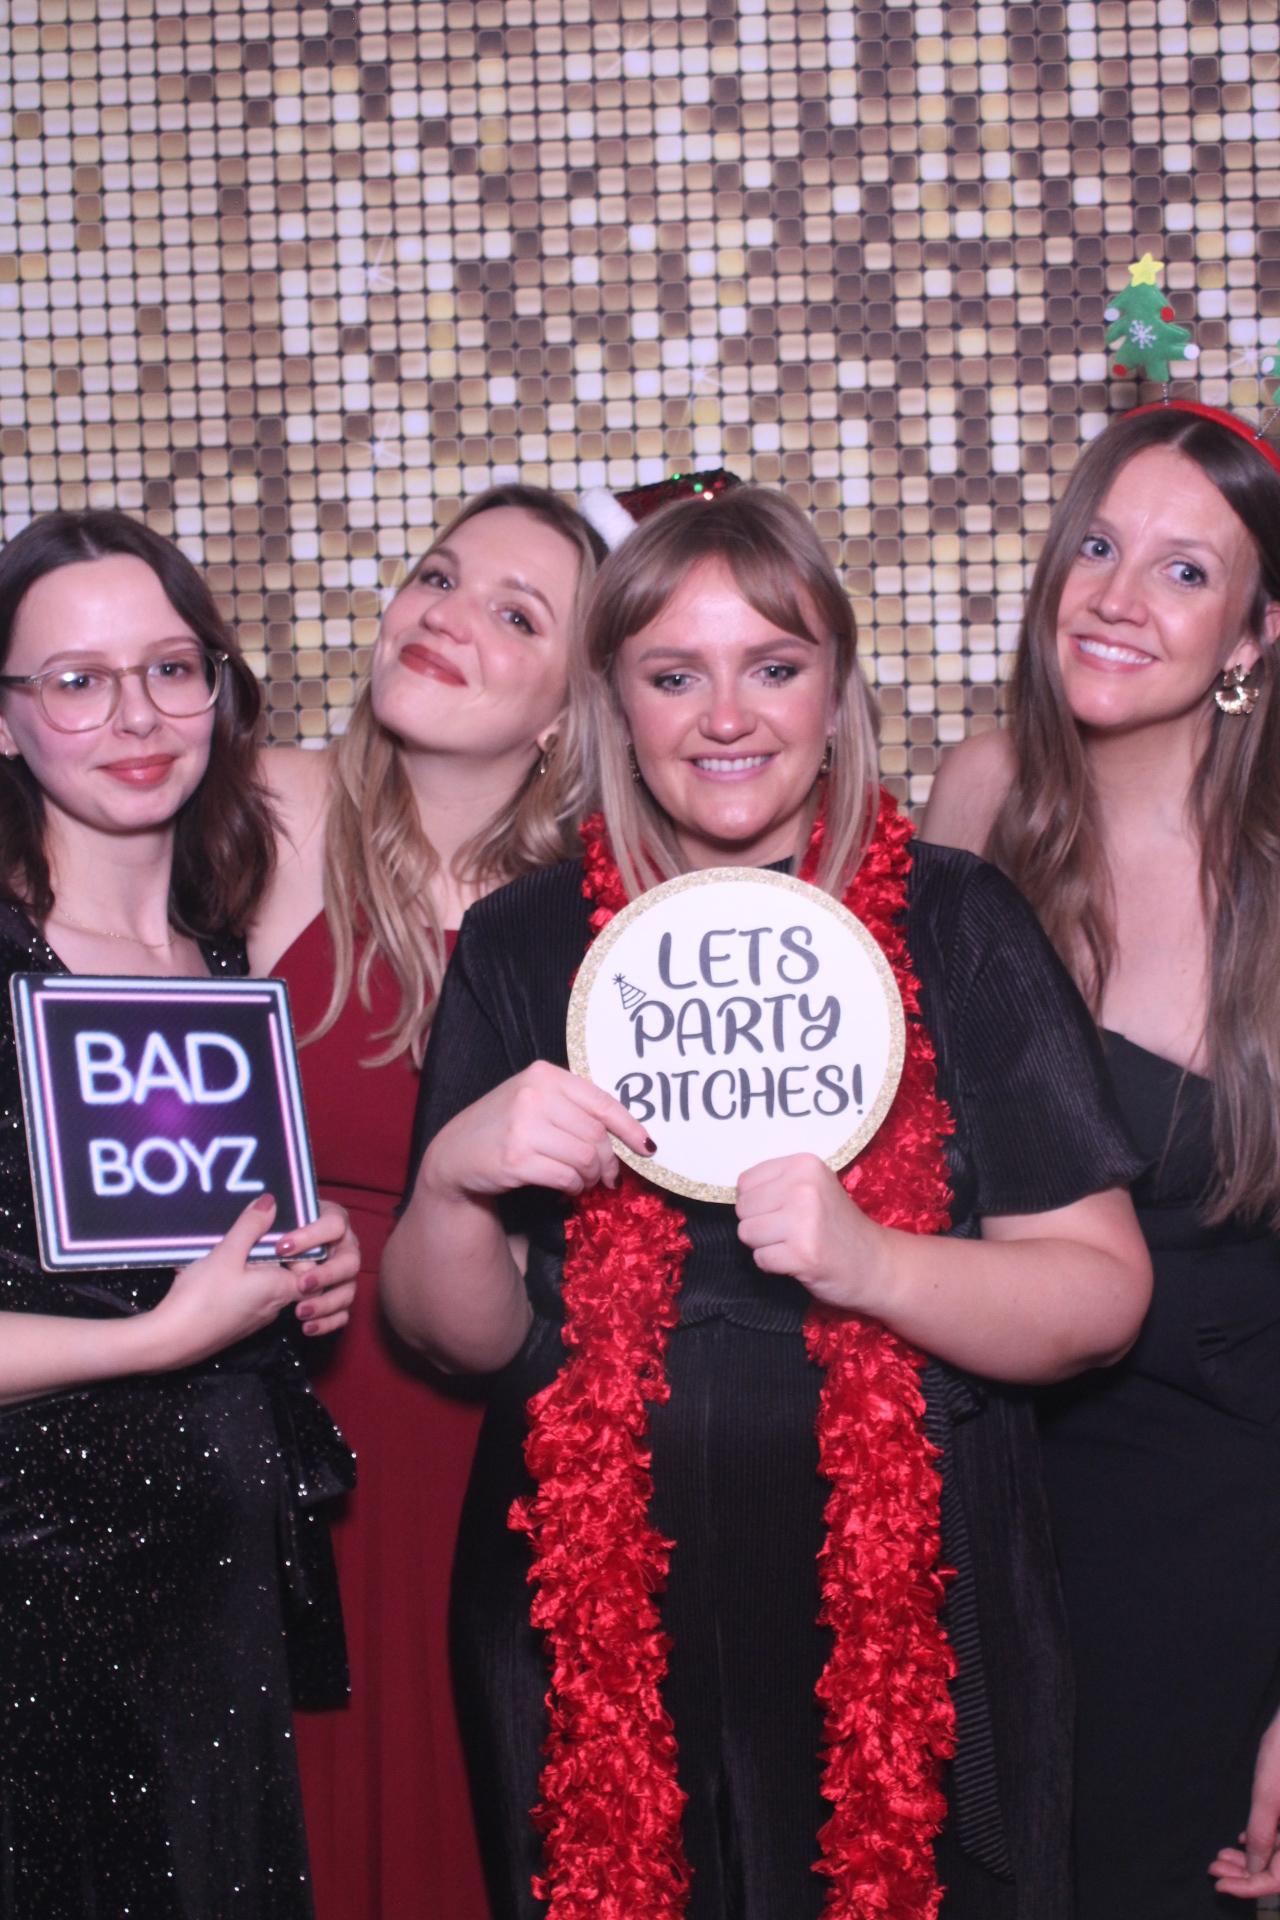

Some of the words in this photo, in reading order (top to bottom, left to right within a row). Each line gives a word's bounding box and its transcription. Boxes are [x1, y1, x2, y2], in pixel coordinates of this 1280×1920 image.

[658, 925, 819, 990] LETS
[629, 993, 841, 1058] PARTY
[75, 1031, 251, 1105] BAD
[614, 1063, 864, 1123] BITCHES!
[89, 1136, 265, 1196] BOYZ
